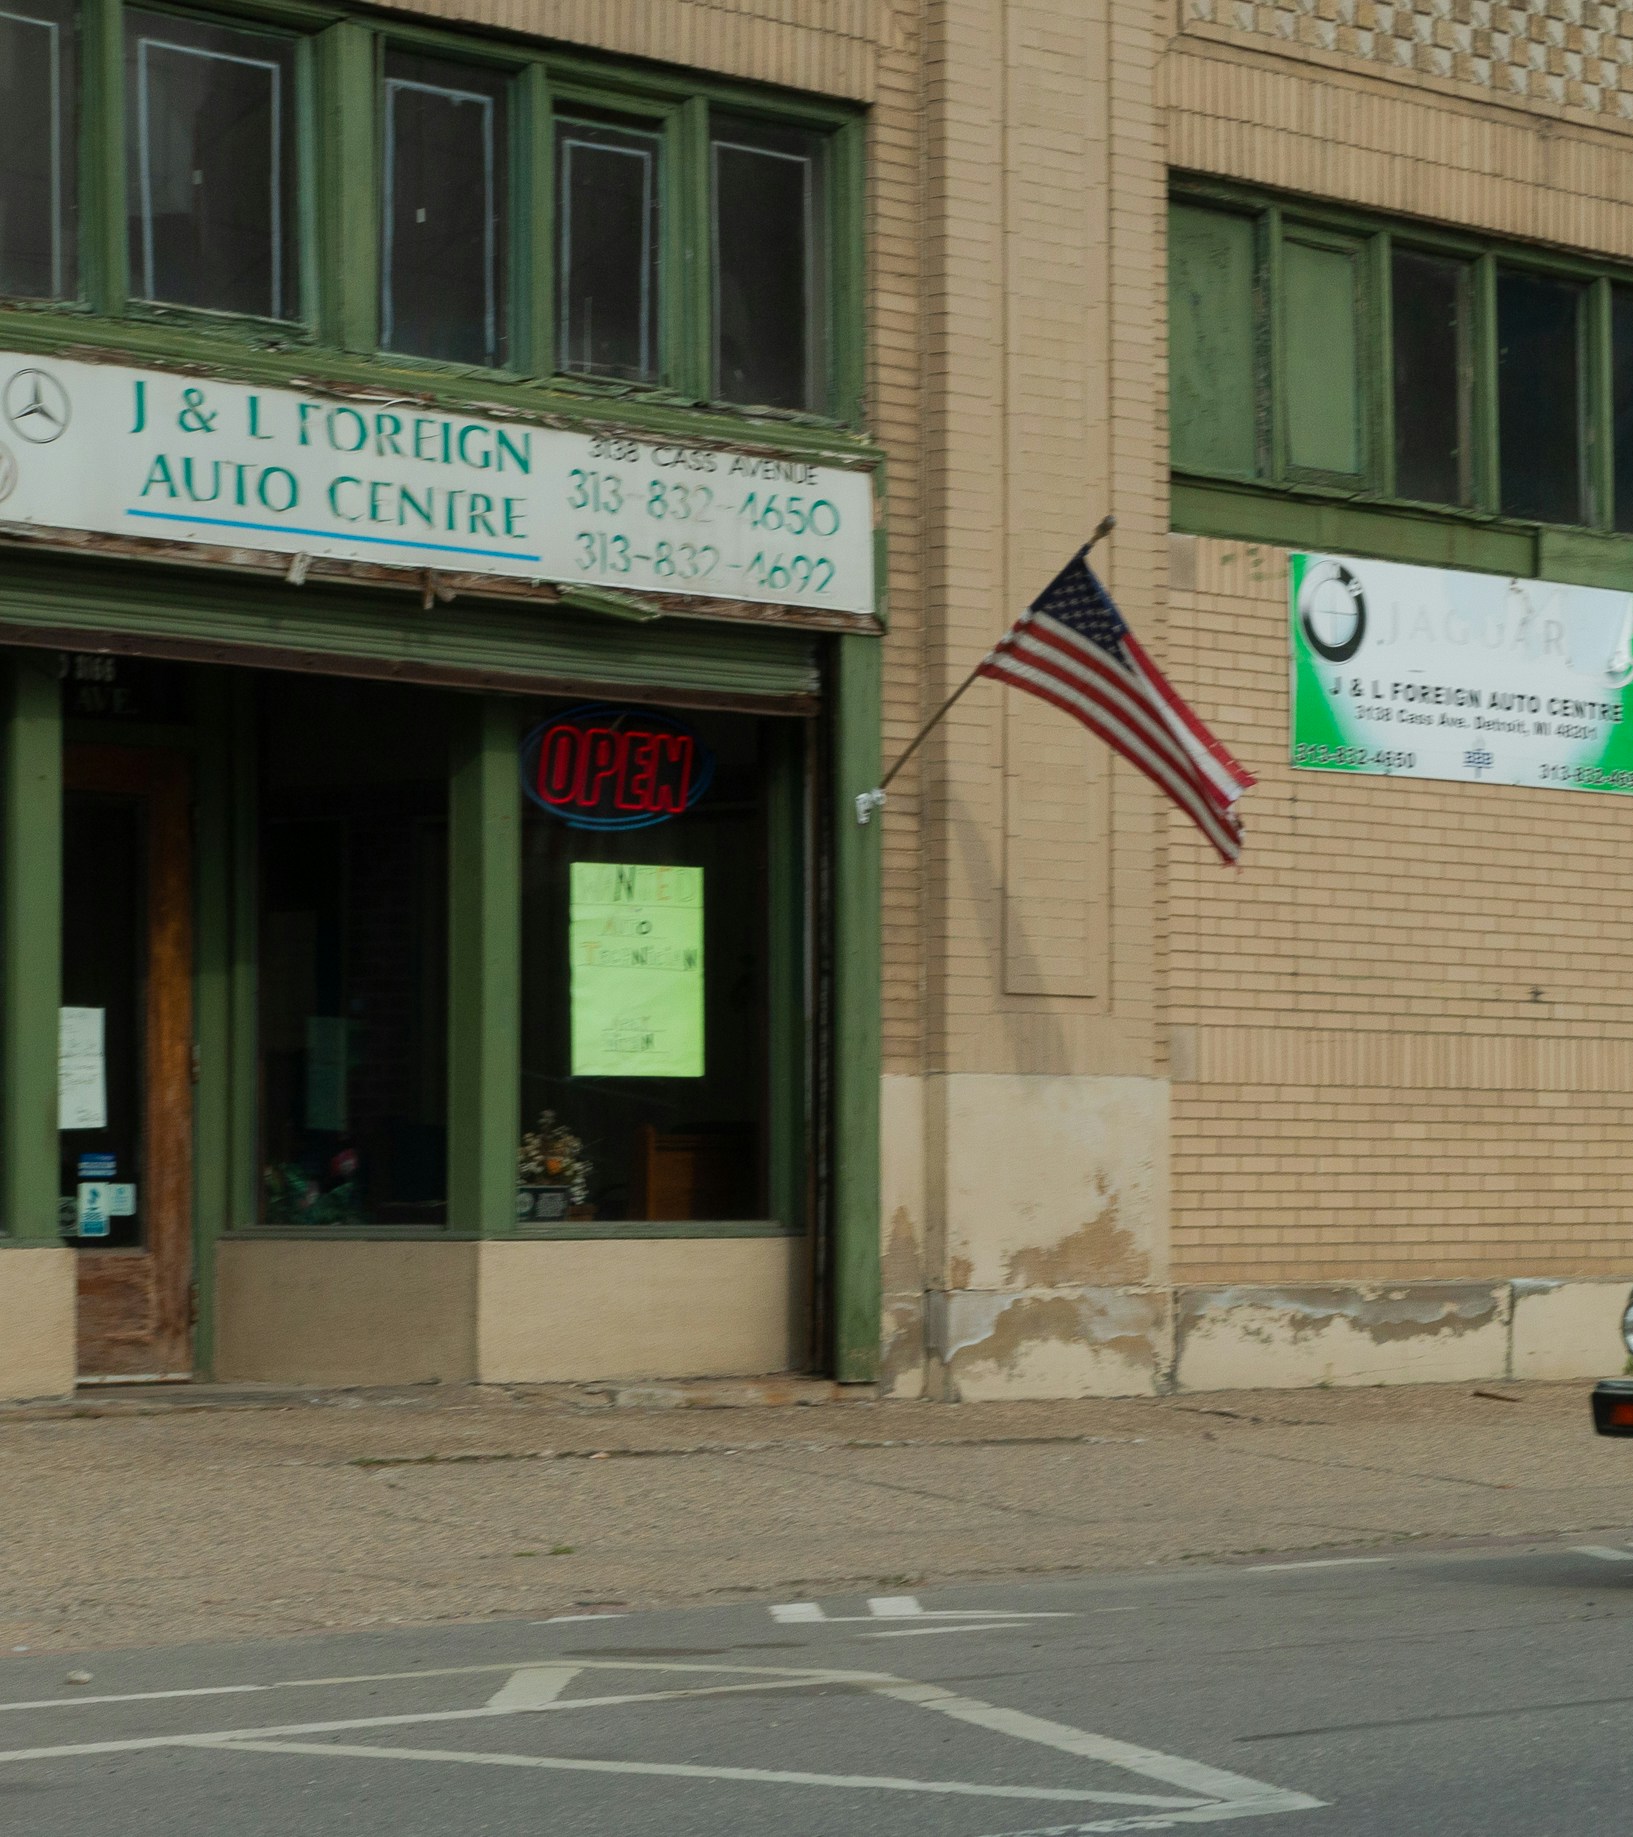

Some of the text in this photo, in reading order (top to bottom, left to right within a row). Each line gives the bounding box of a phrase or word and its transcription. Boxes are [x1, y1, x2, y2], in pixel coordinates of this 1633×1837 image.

[130, 380, 534, 476] J & L FOREIGN
[139, 453, 530, 539] AUTO CENTRE
[651, 446, 718, 473] CASS
[727, 454, 819, 485] AVENUE
[1328, 676, 1625, 723] J & L FOREIGN AUTO CENTRE
[1396, 708, 1434, 726] Cass
[537, 724, 694, 814] OPEN
